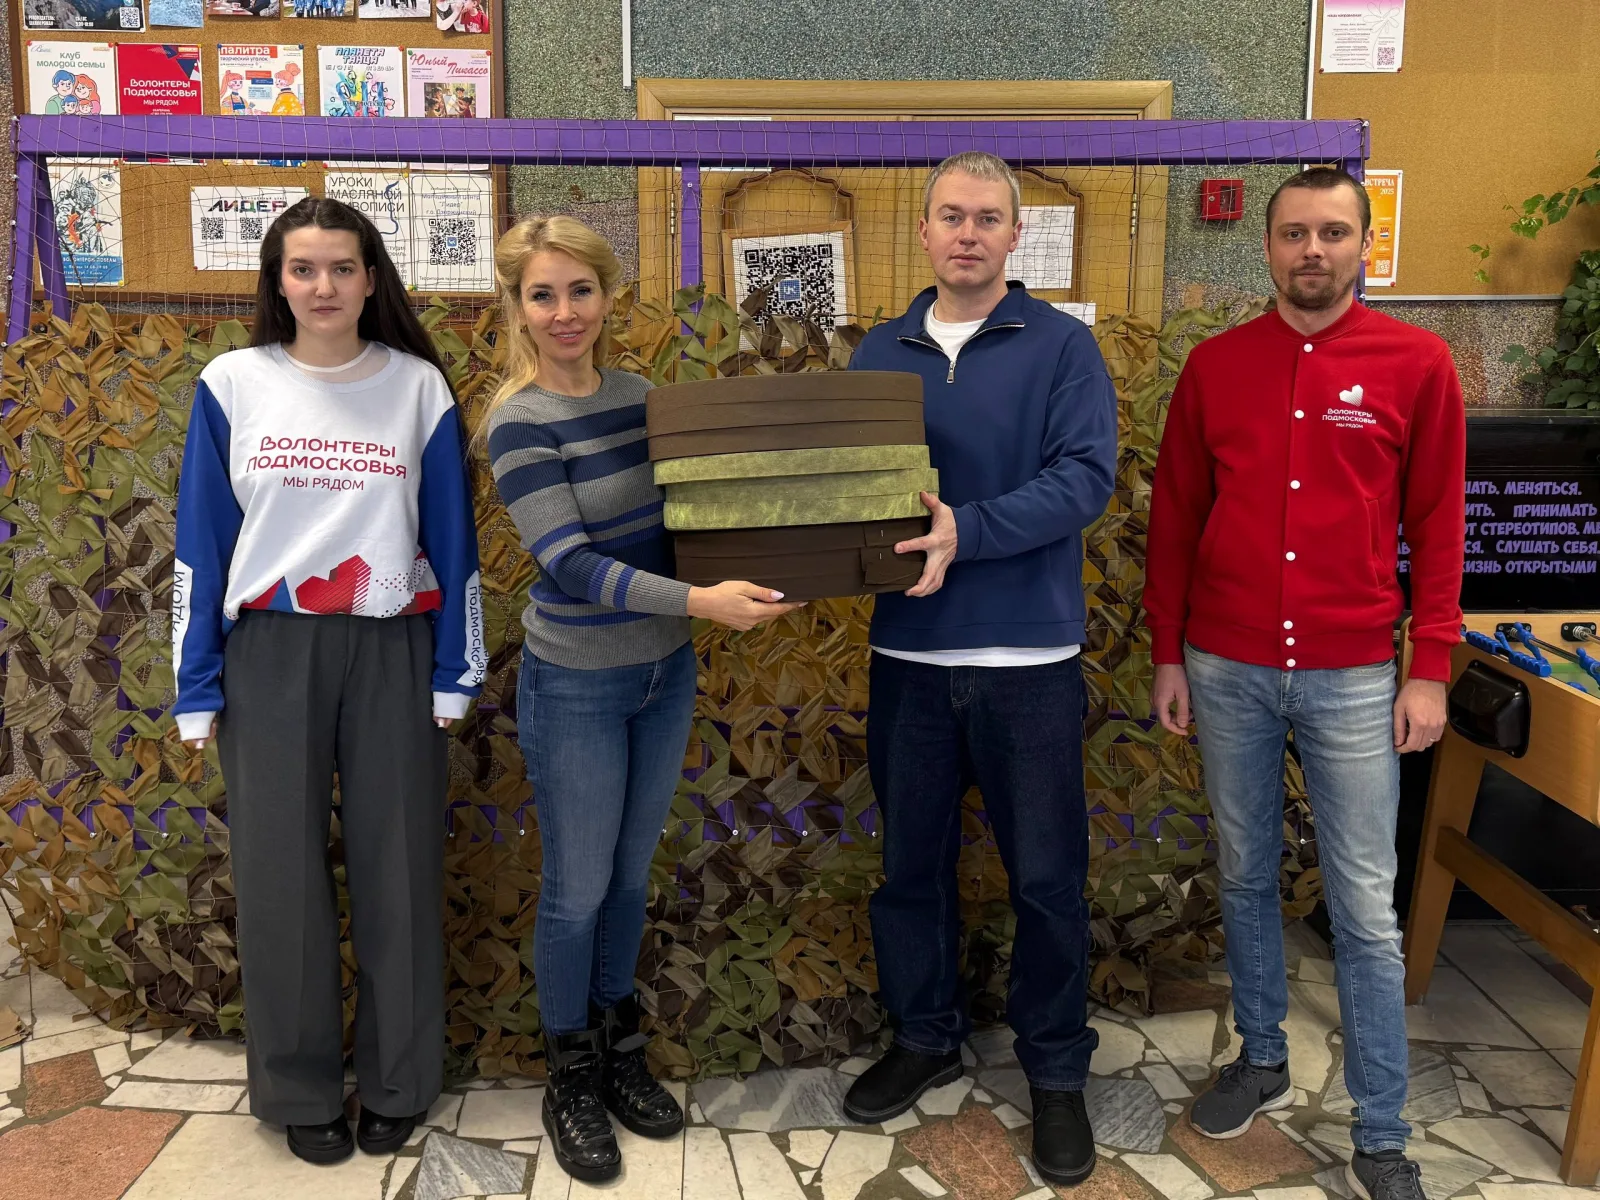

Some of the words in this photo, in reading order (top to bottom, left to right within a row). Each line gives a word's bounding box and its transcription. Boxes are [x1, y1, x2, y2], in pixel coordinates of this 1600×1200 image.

[60, 52, 80, 60] клуб
[221, 46, 270, 55] палитра
[335, 48, 385, 56] ПЛАНЕТА
[343, 56, 378, 65] ТАНЦА
[410, 54, 448, 65] Юный
[447, 62, 488, 74] Пикассо
[130, 79, 190, 88] ВОЛОНТЕРЫ
[124, 88, 197, 97] ПОДМОСКОВЬЯ
[330, 177, 372, 187] УРОКИ
[331, 188, 402, 199] МАСЛЯНОЙ
[208, 200, 288, 213] ЛИДЕР
[342, 202, 404, 212] ВОПИСИ
[1328, 408, 1372, 417] ВОЛОНТЕРЫ
[1322, 415, 1376, 424] ПОДМОСКОВЬЯ
[260, 436, 396, 458] ВОЛОНТЕРЫ
[246, 456, 407, 479] ПОДМОСКОВЬЯ
[283, 477, 307, 488] МЫ
[312, 478, 364, 491] РЯДОМ
[1504, 482, 1582, 495] МЕНЯТЬСЯ.
[1513, 503, 1597, 518] ПРИНИМАТЬ
[1480, 522, 1580, 535] СТЕРЕОТИПОВ.
[1496, 540, 1559, 554] СЛУШАТЬ
[1563, 541, 1600, 554] СЕБЯ.
[1505, 560, 1597, 573] ОТКРЫТЫМИ
[469, 586, 485, 684] ПОДМОСКОВЬЯ
